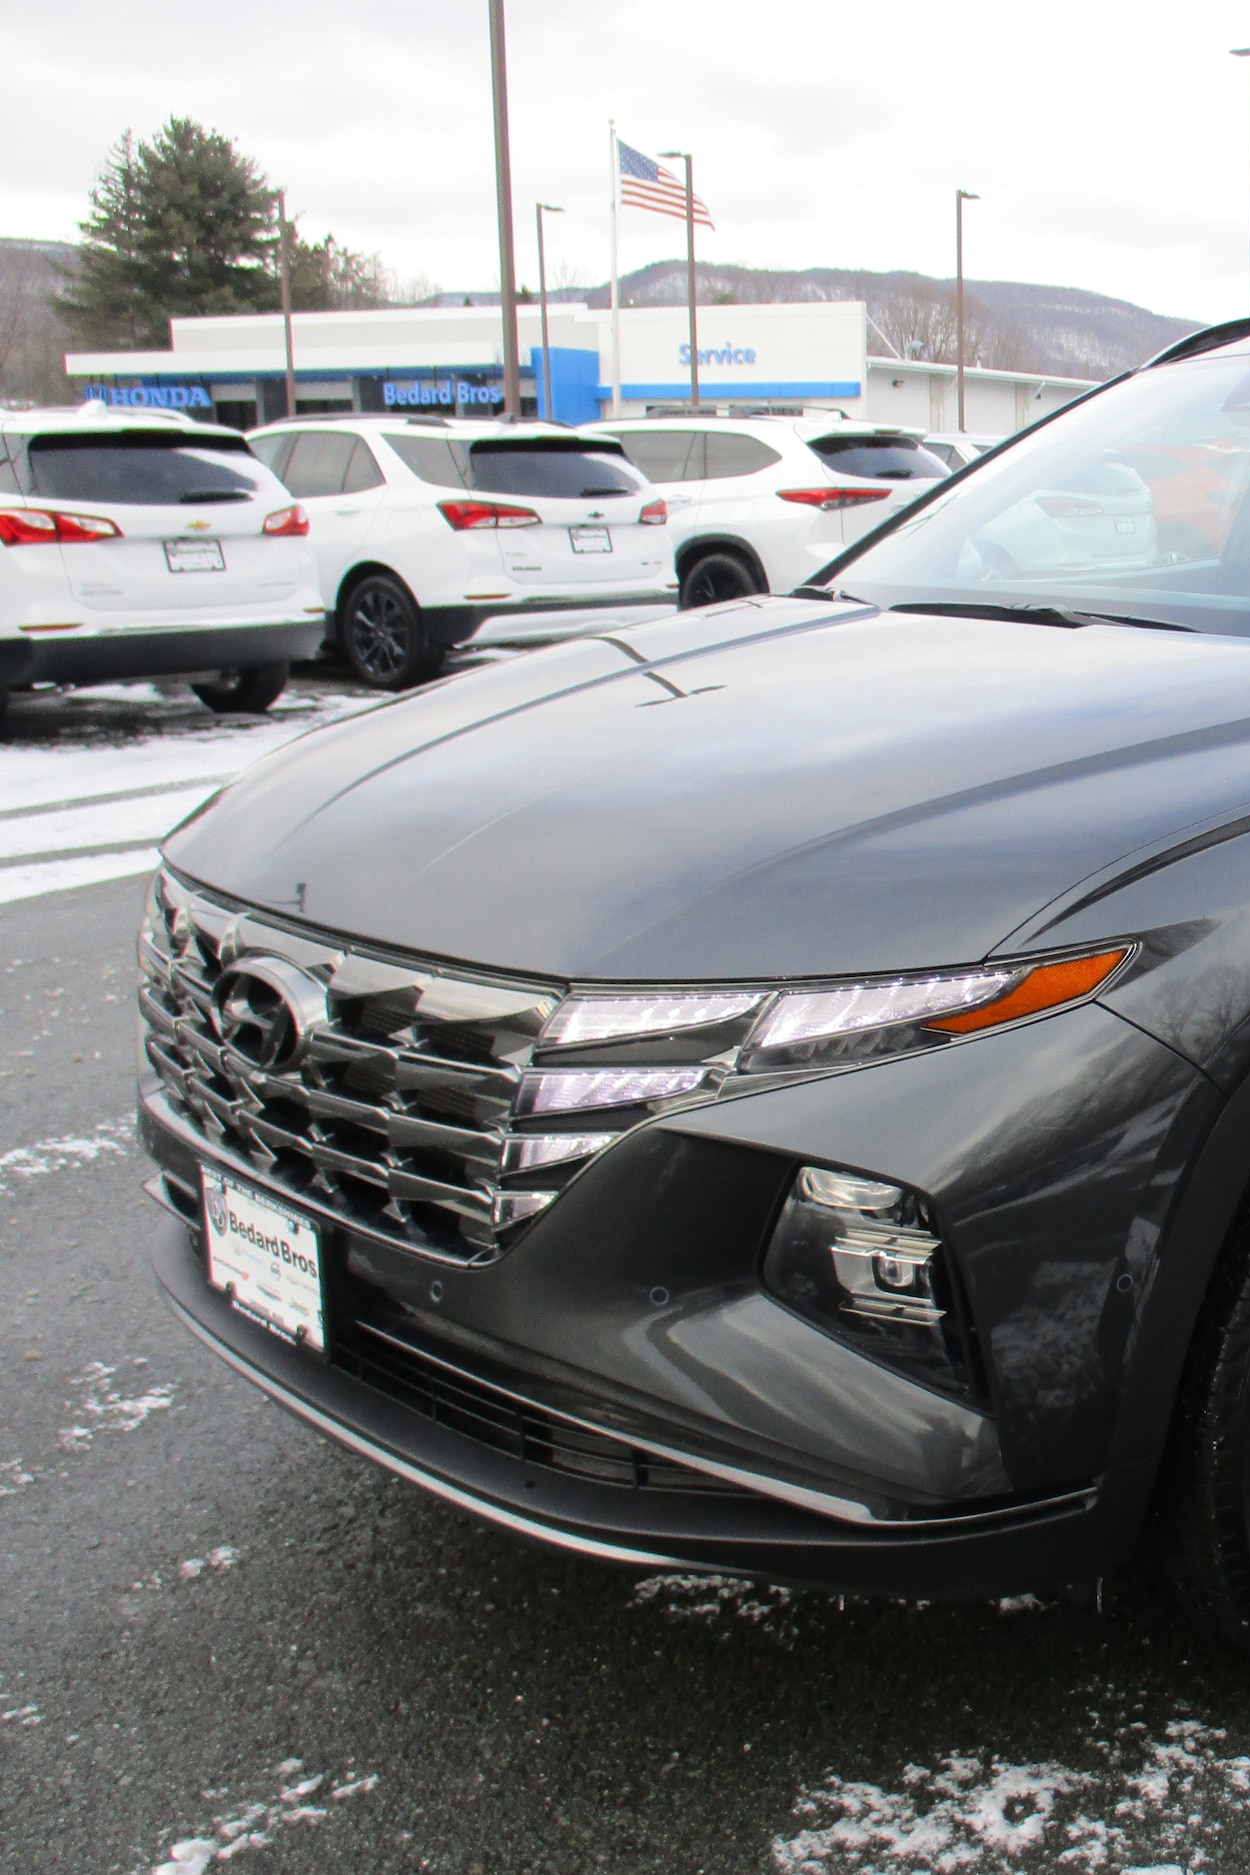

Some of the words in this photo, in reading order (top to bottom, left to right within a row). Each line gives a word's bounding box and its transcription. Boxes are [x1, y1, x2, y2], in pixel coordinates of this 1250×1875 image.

[678, 341, 756, 365] Service
[110, 386, 213, 407] HONDA
[383, 381, 454, 405] Bedard
[457, 381, 502, 404] Bros
[229, 1210, 280, 1258] Bedard
[280, 1239, 317, 1276] Bros
